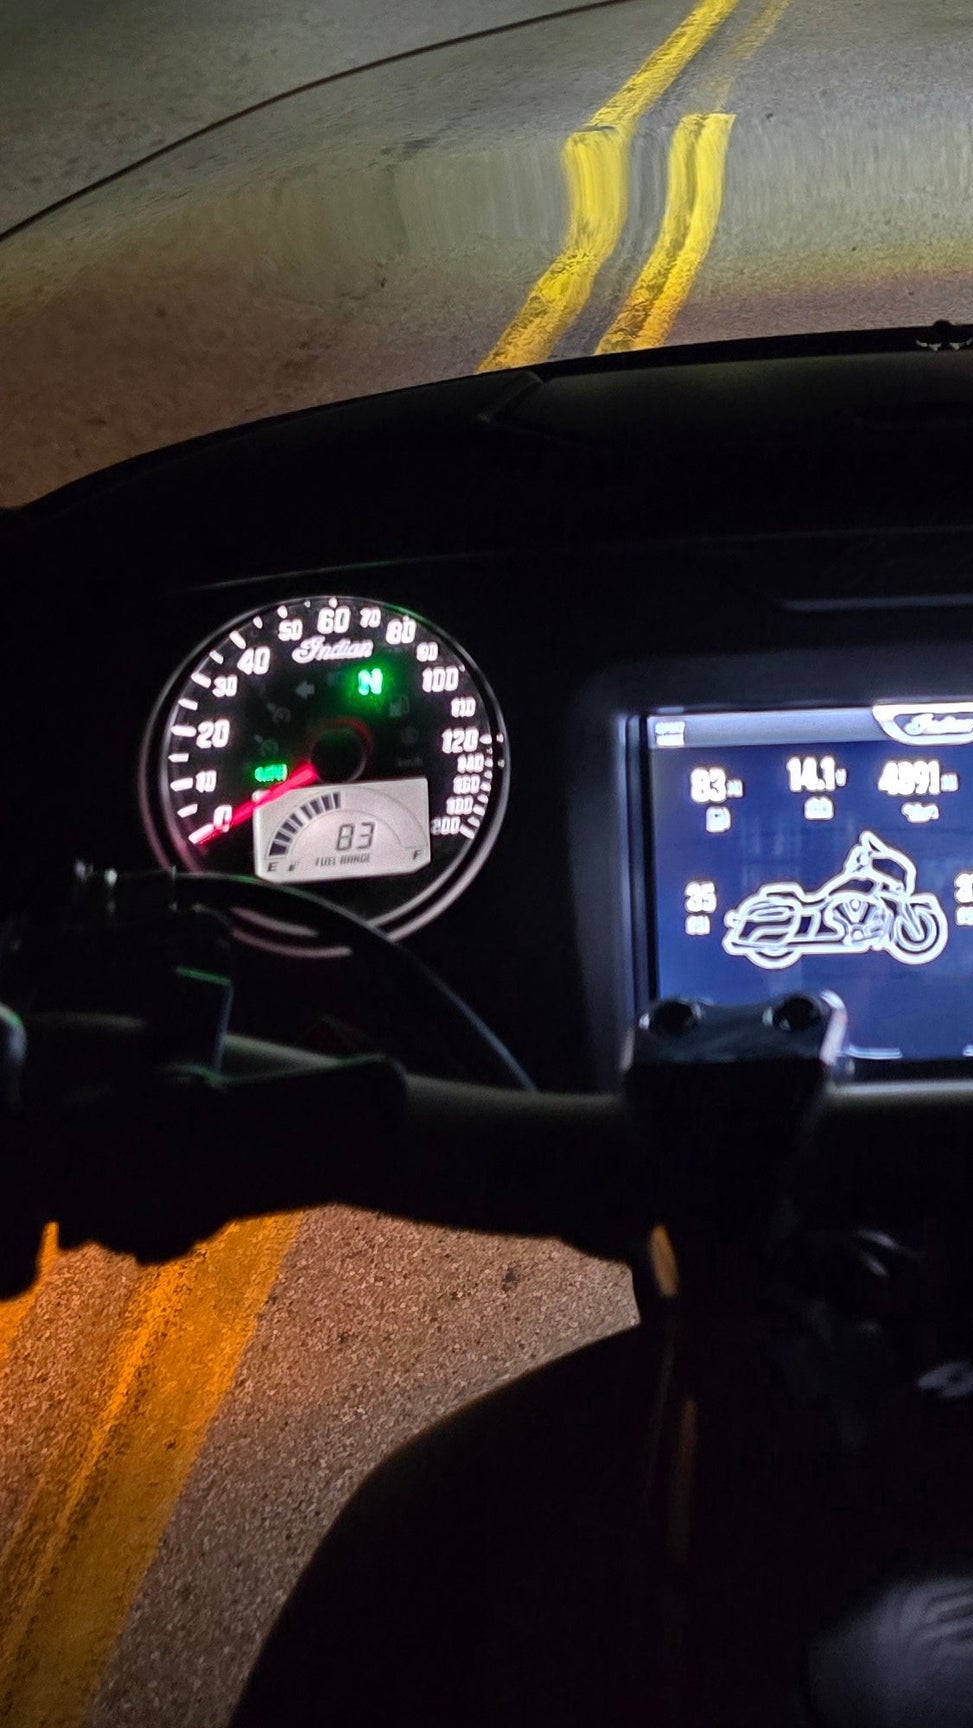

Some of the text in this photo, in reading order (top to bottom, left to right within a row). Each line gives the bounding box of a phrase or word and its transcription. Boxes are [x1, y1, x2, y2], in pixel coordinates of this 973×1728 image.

[278, 618, 303, 642] 50
[316, 607, 351, 635] 60
[359, 606, 381, 629] 70
[386, 619, 417, 645] 80
[236, 646, 271, 676] 40
[291, 634, 374, 664] Indian
[416, 641, 439, 662] 90
[212, 674, 239, 698] 30
[357, 667, 384, 697] N
[422, 664, 460, 693] 100
[196, 720, 231, 750] 20
[441, 725, 480, 754] 120
[195, 770, 218, 792] 10
[690, 767, 728, 803] 83
[786, 756, 837, 792] 14.1
[336, 822, 376, 852] 83
[266, 862, 278, 872] E
[412, 849, 423, 860] F
